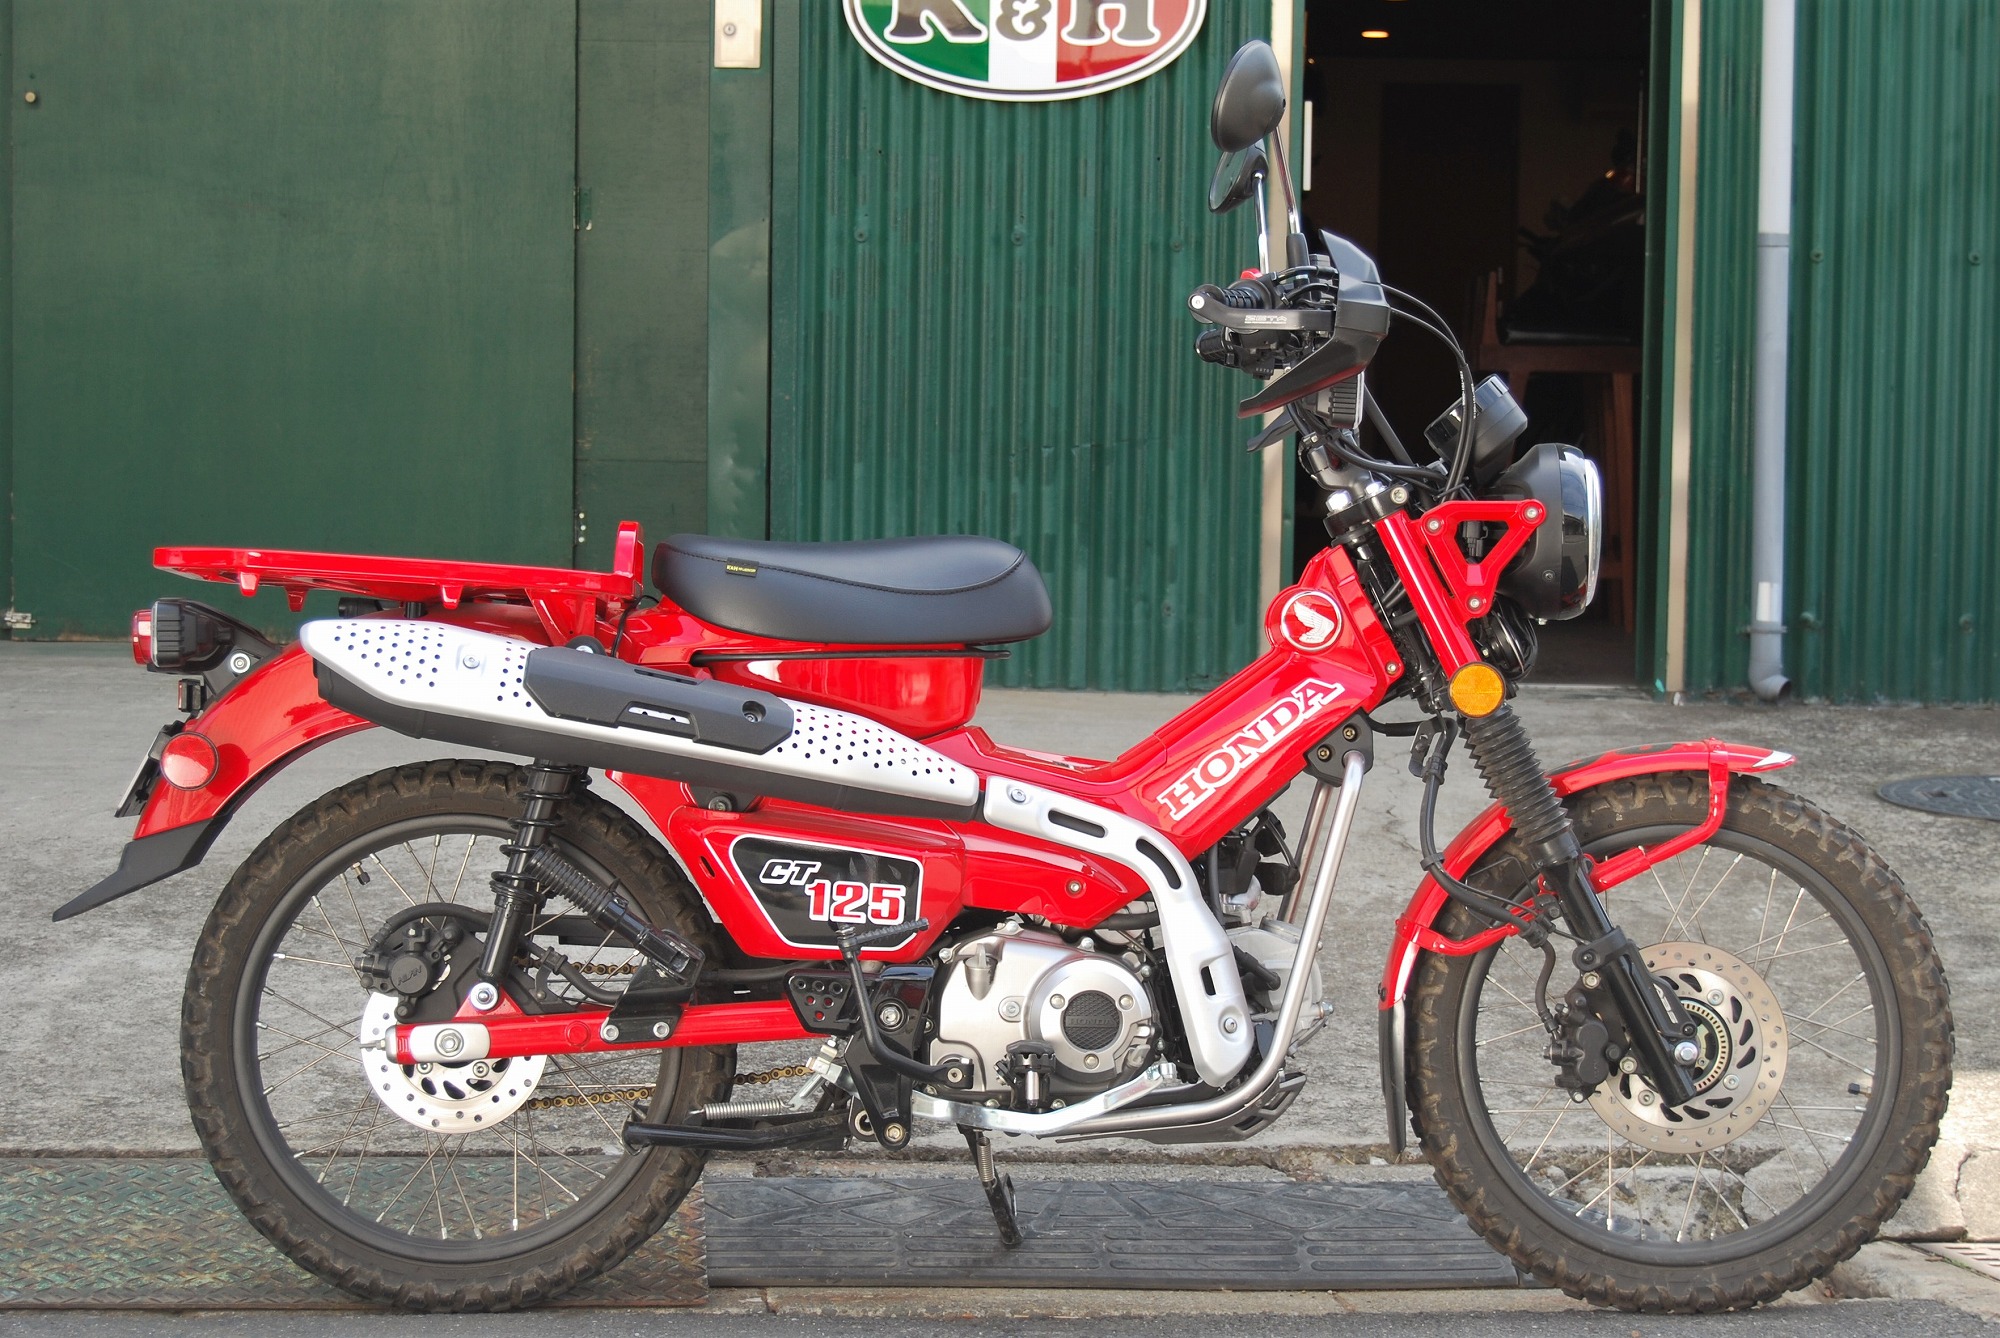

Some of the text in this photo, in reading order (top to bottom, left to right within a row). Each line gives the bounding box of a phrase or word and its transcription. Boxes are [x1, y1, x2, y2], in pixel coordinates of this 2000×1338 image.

[1157, 678, 1345, 821] HONDA
[759, 858, 822, 885] CT
[804, 879, 907, 925] 125
